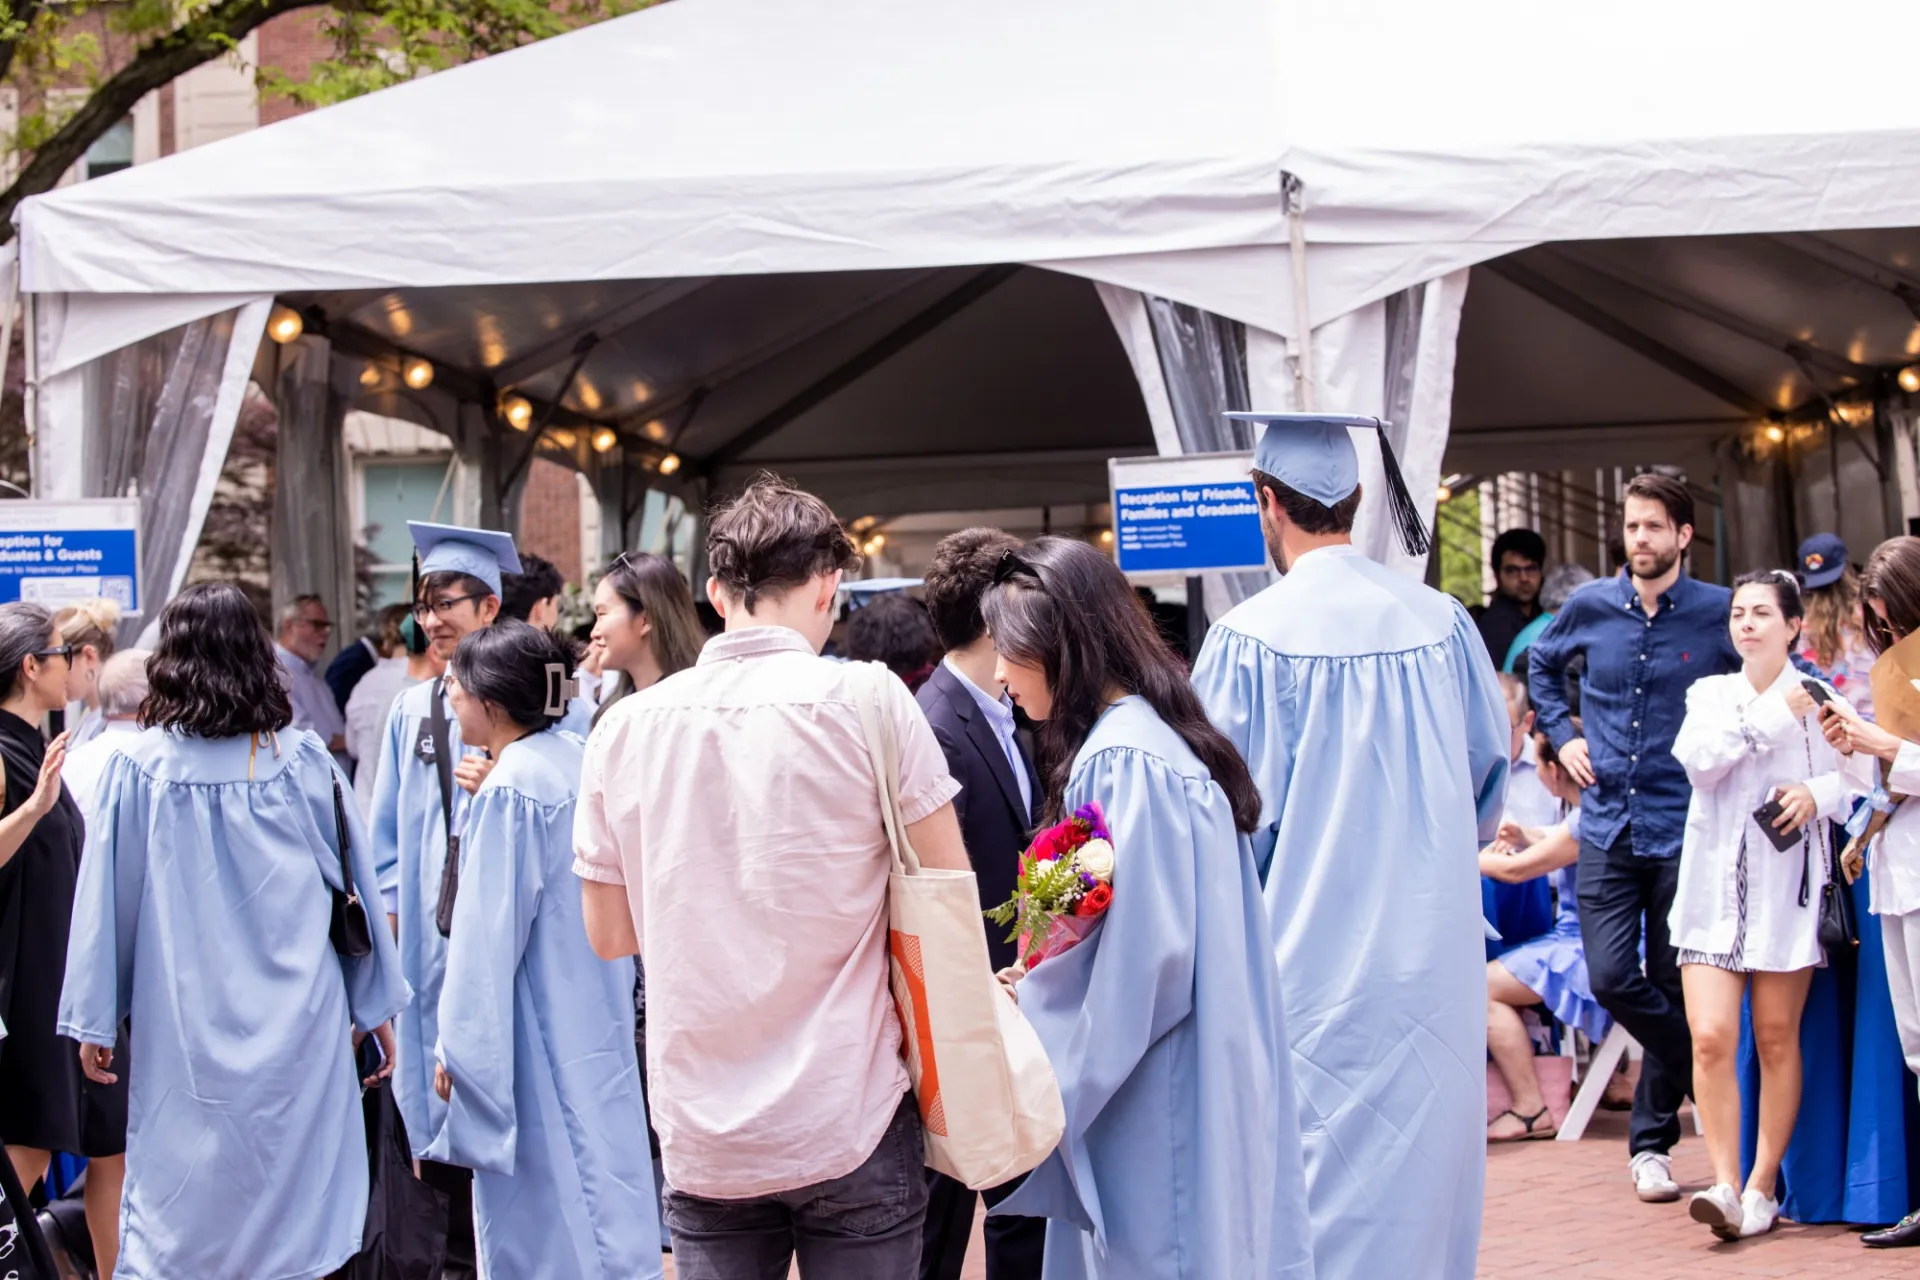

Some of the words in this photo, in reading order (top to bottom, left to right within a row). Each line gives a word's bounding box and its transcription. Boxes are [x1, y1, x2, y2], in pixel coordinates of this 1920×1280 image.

[1119, 490, 1180, 505] Reception
[1181, 489, 1200, 502] for
[1202, 486, 1251, 500] Friends,
[1121, 506, 1170, 520] Families
[1171, 505, 1195, 518] and
[1196, 503, 1258, 517] Graduates
[43, 534, 64, 547] for
[44, 548, 55, 561] &
[57, 548, 103, 561] Guests
